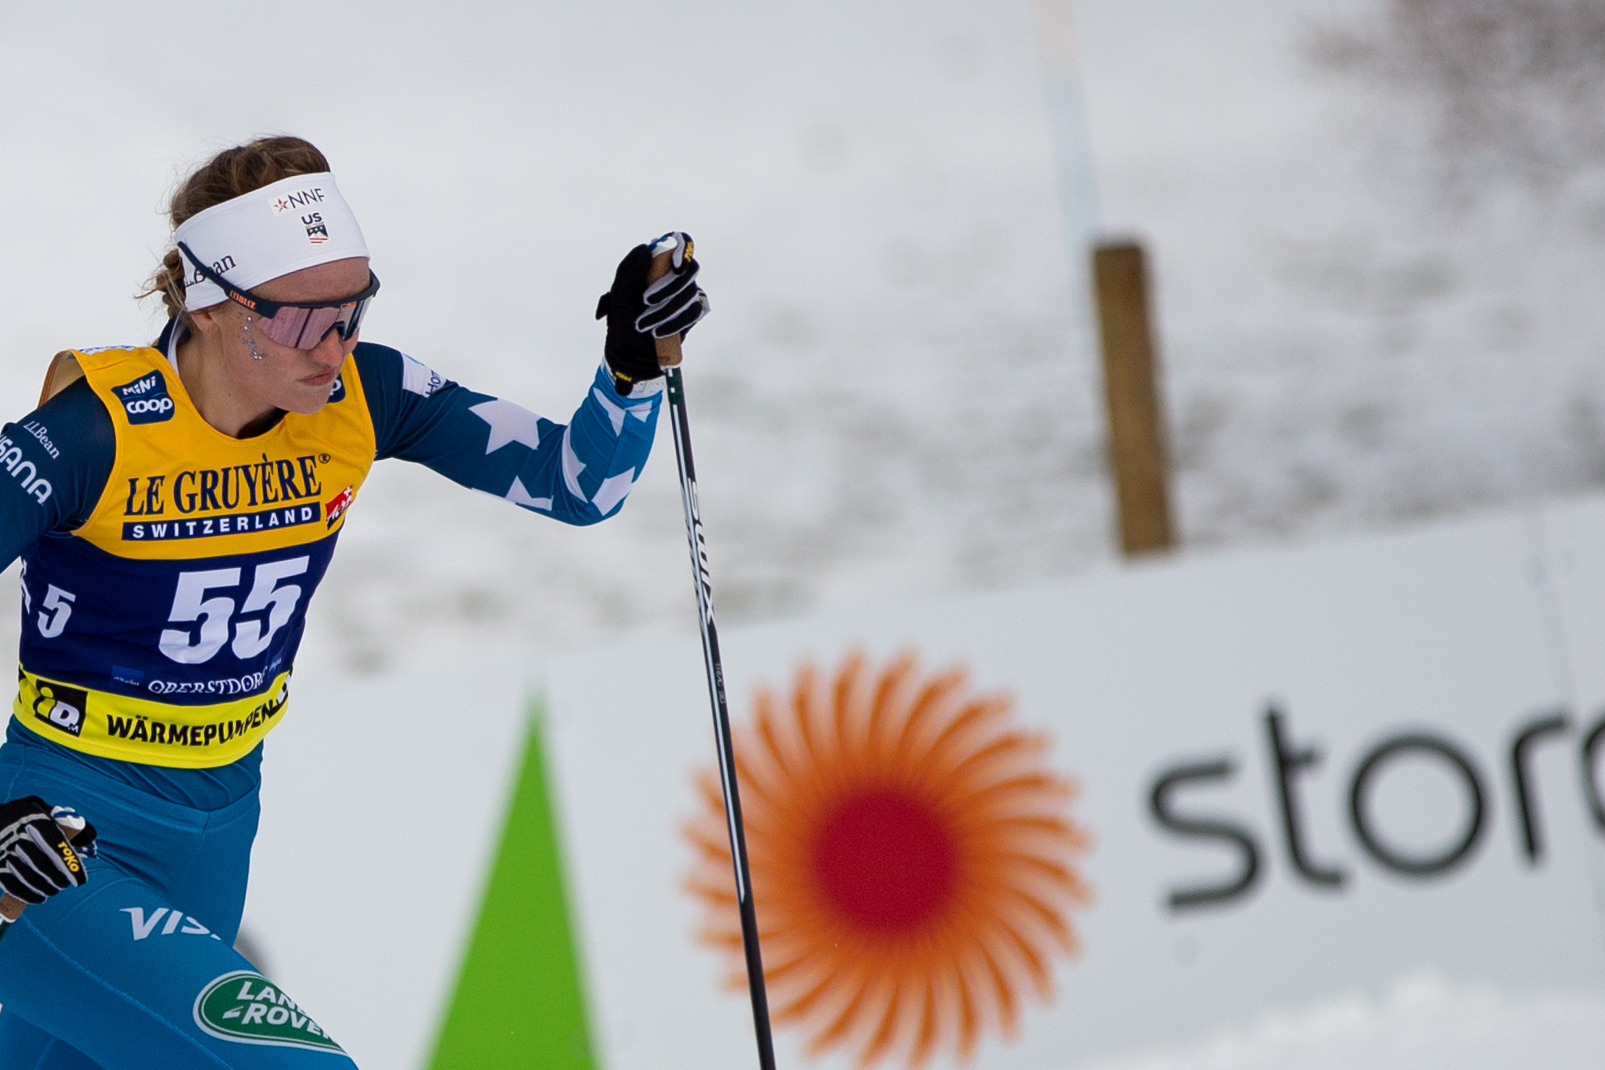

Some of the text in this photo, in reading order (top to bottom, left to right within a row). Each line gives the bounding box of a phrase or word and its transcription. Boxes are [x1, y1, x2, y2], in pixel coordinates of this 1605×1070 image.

[288, 188, 325, 209] NNF
[301, 212, 323, 225] US
[124, 475, 165, 516] LE
[133, 507, 313, 539] SWITZERLAND
[158, 555, 310, 664] 55
[1146, 703, 1605, 910] stor
[58, 841, 80, 872] TOKO
[119, 907, 221, 941] VIS
